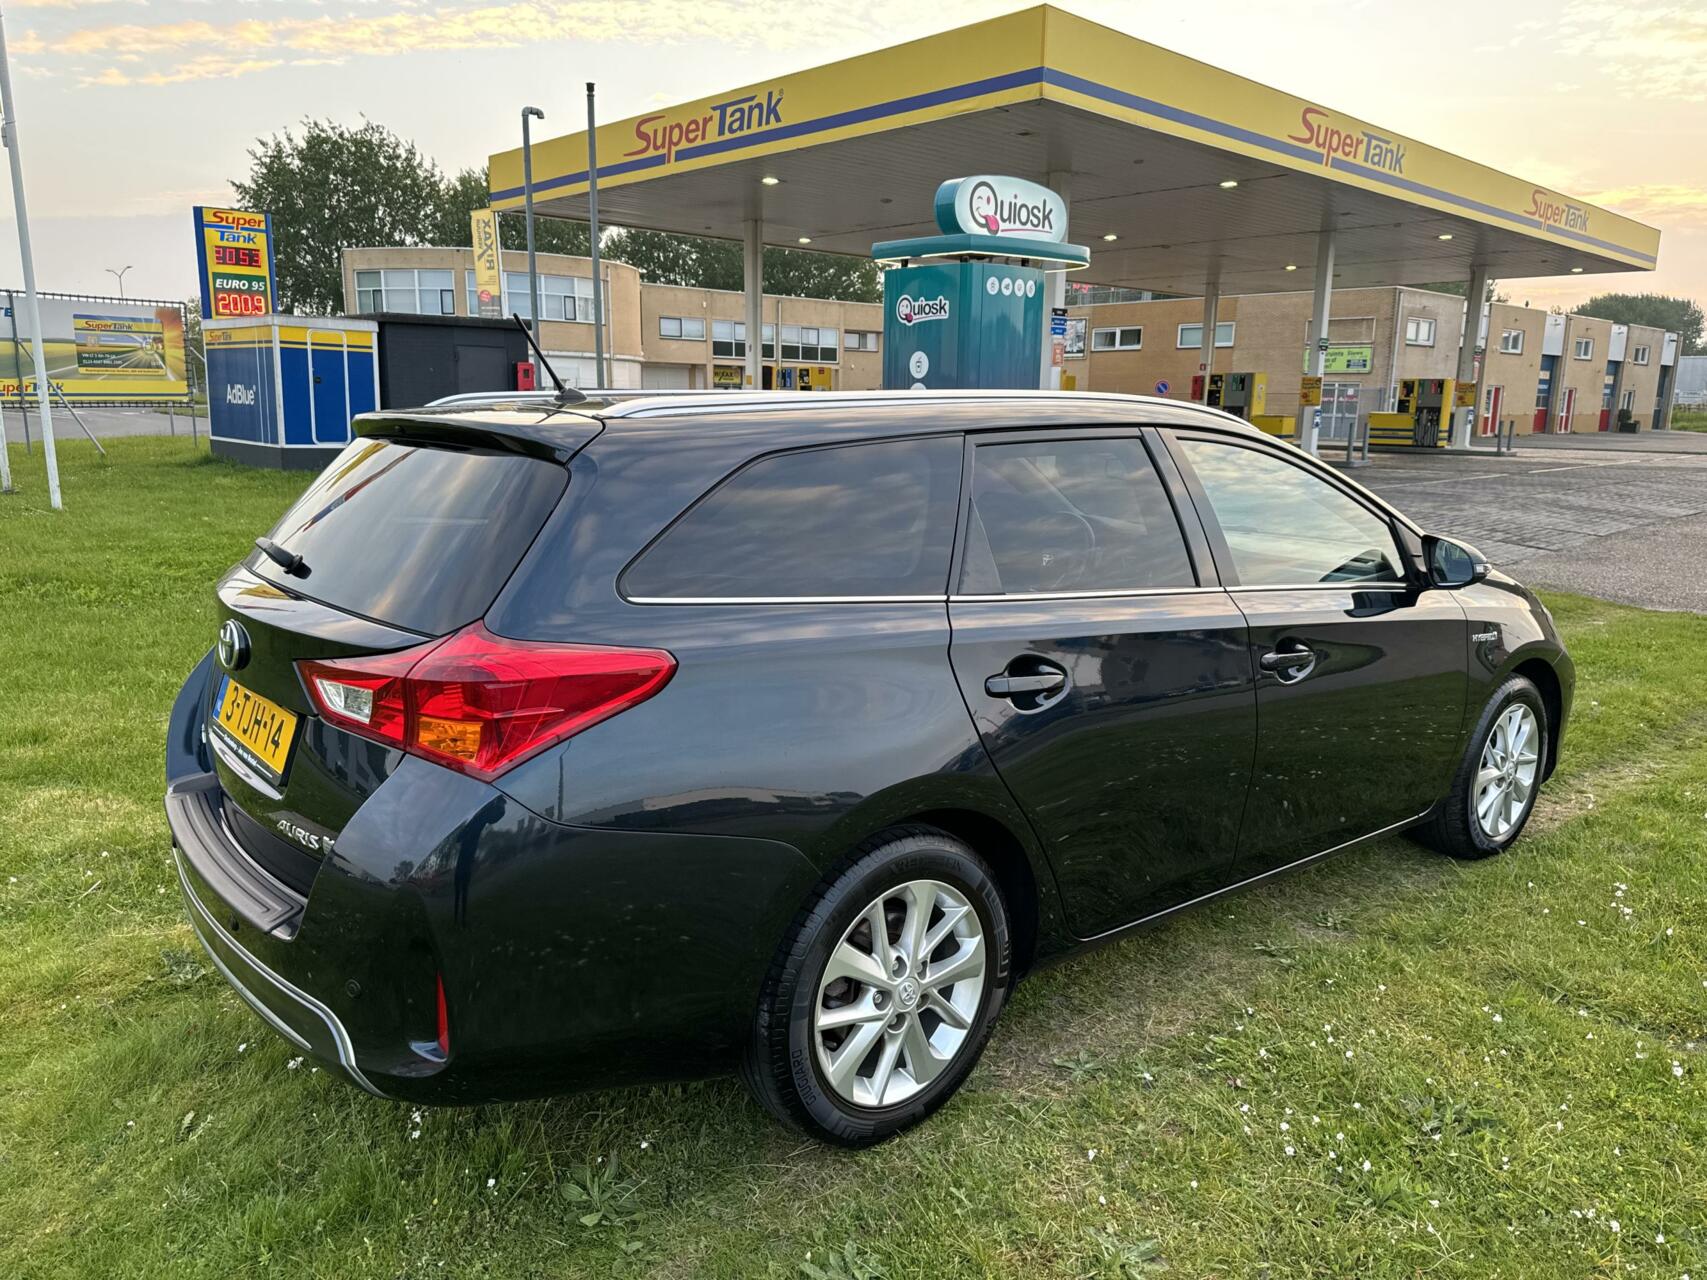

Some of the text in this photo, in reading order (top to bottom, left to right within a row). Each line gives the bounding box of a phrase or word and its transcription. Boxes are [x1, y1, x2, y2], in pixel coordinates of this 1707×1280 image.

[1288, 107, 1405, 174] SuperTank
[203, 210, 265, 230] Super
[970, 181, 1053, 235] Quiosk
[1523, 189, 1589, 232] SuperTank
[215, 229, 258, 244] Tank
[215, 279, 266, 291] EURO 95
[898, 297, 947, 323] Quiosk
[226, 384, 255, 405] AdBlue
[226, 686, 285, 758] 3-TJH-14
[277, 820, 319, 849] AURIS
